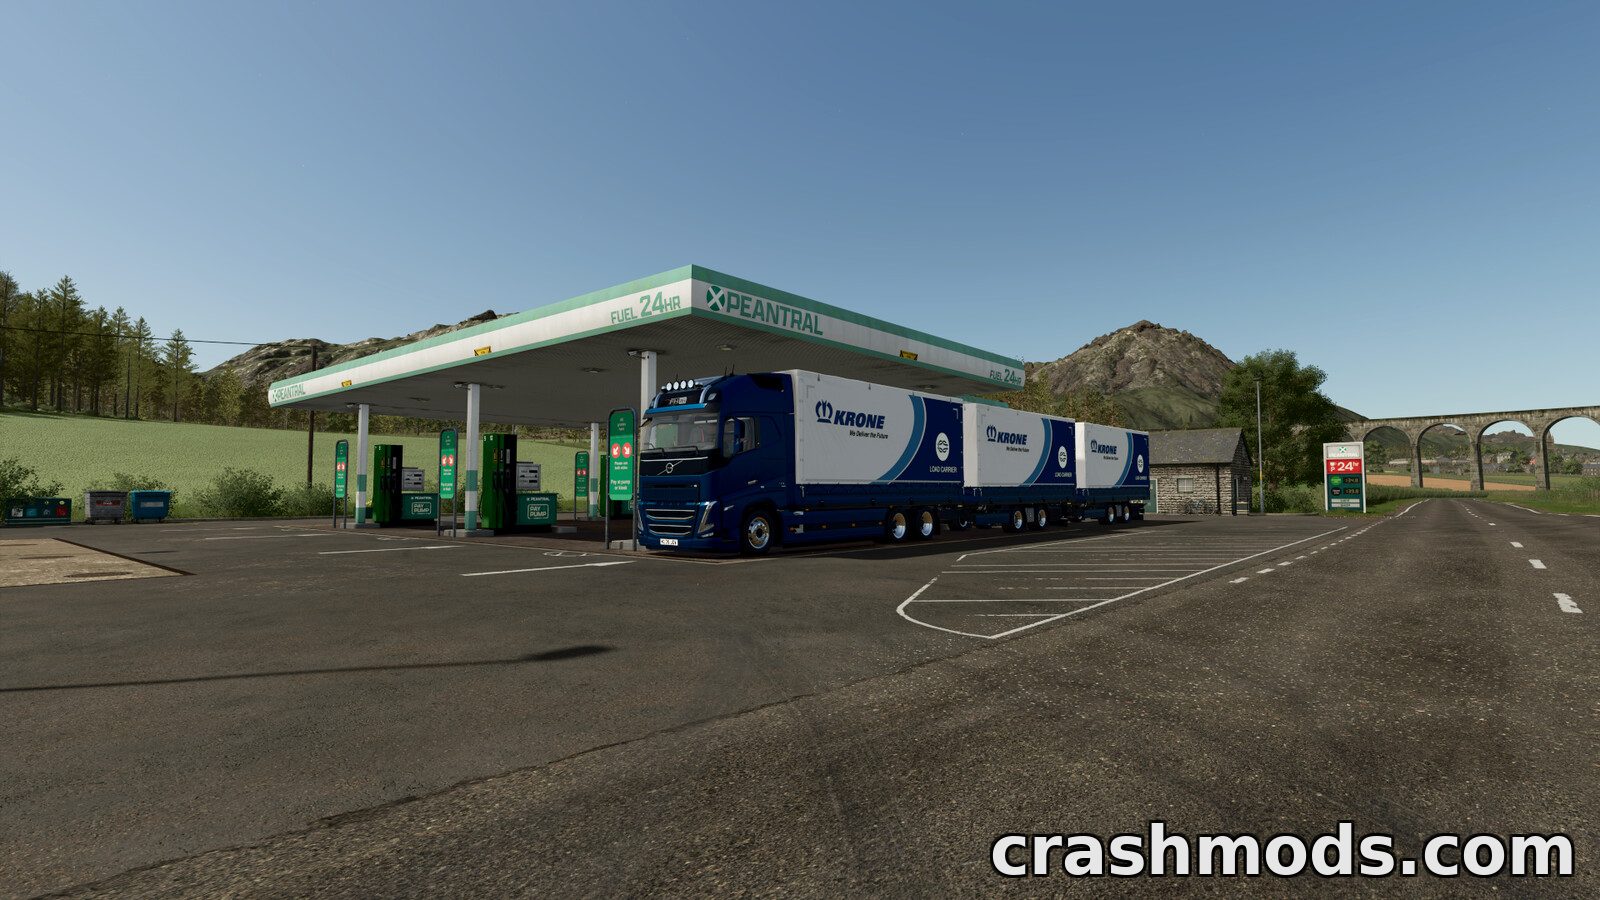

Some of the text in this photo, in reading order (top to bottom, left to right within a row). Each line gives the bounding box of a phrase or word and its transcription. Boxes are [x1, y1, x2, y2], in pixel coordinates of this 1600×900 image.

[610, 291, 681, 324] FUEL 24HR
[726, 291, 823, 336] PEANTRAL
[990, 369, 1022, 384] FUEL 24HR
[278, 383, 306, 400] PEANTRAL
[833, 409, 886, 429] KRONE
[997, 431, 1028, 445] KRONE
[1098, 444, 1117, 455] KRONE
[929, 465, 940, 473] LOAD
